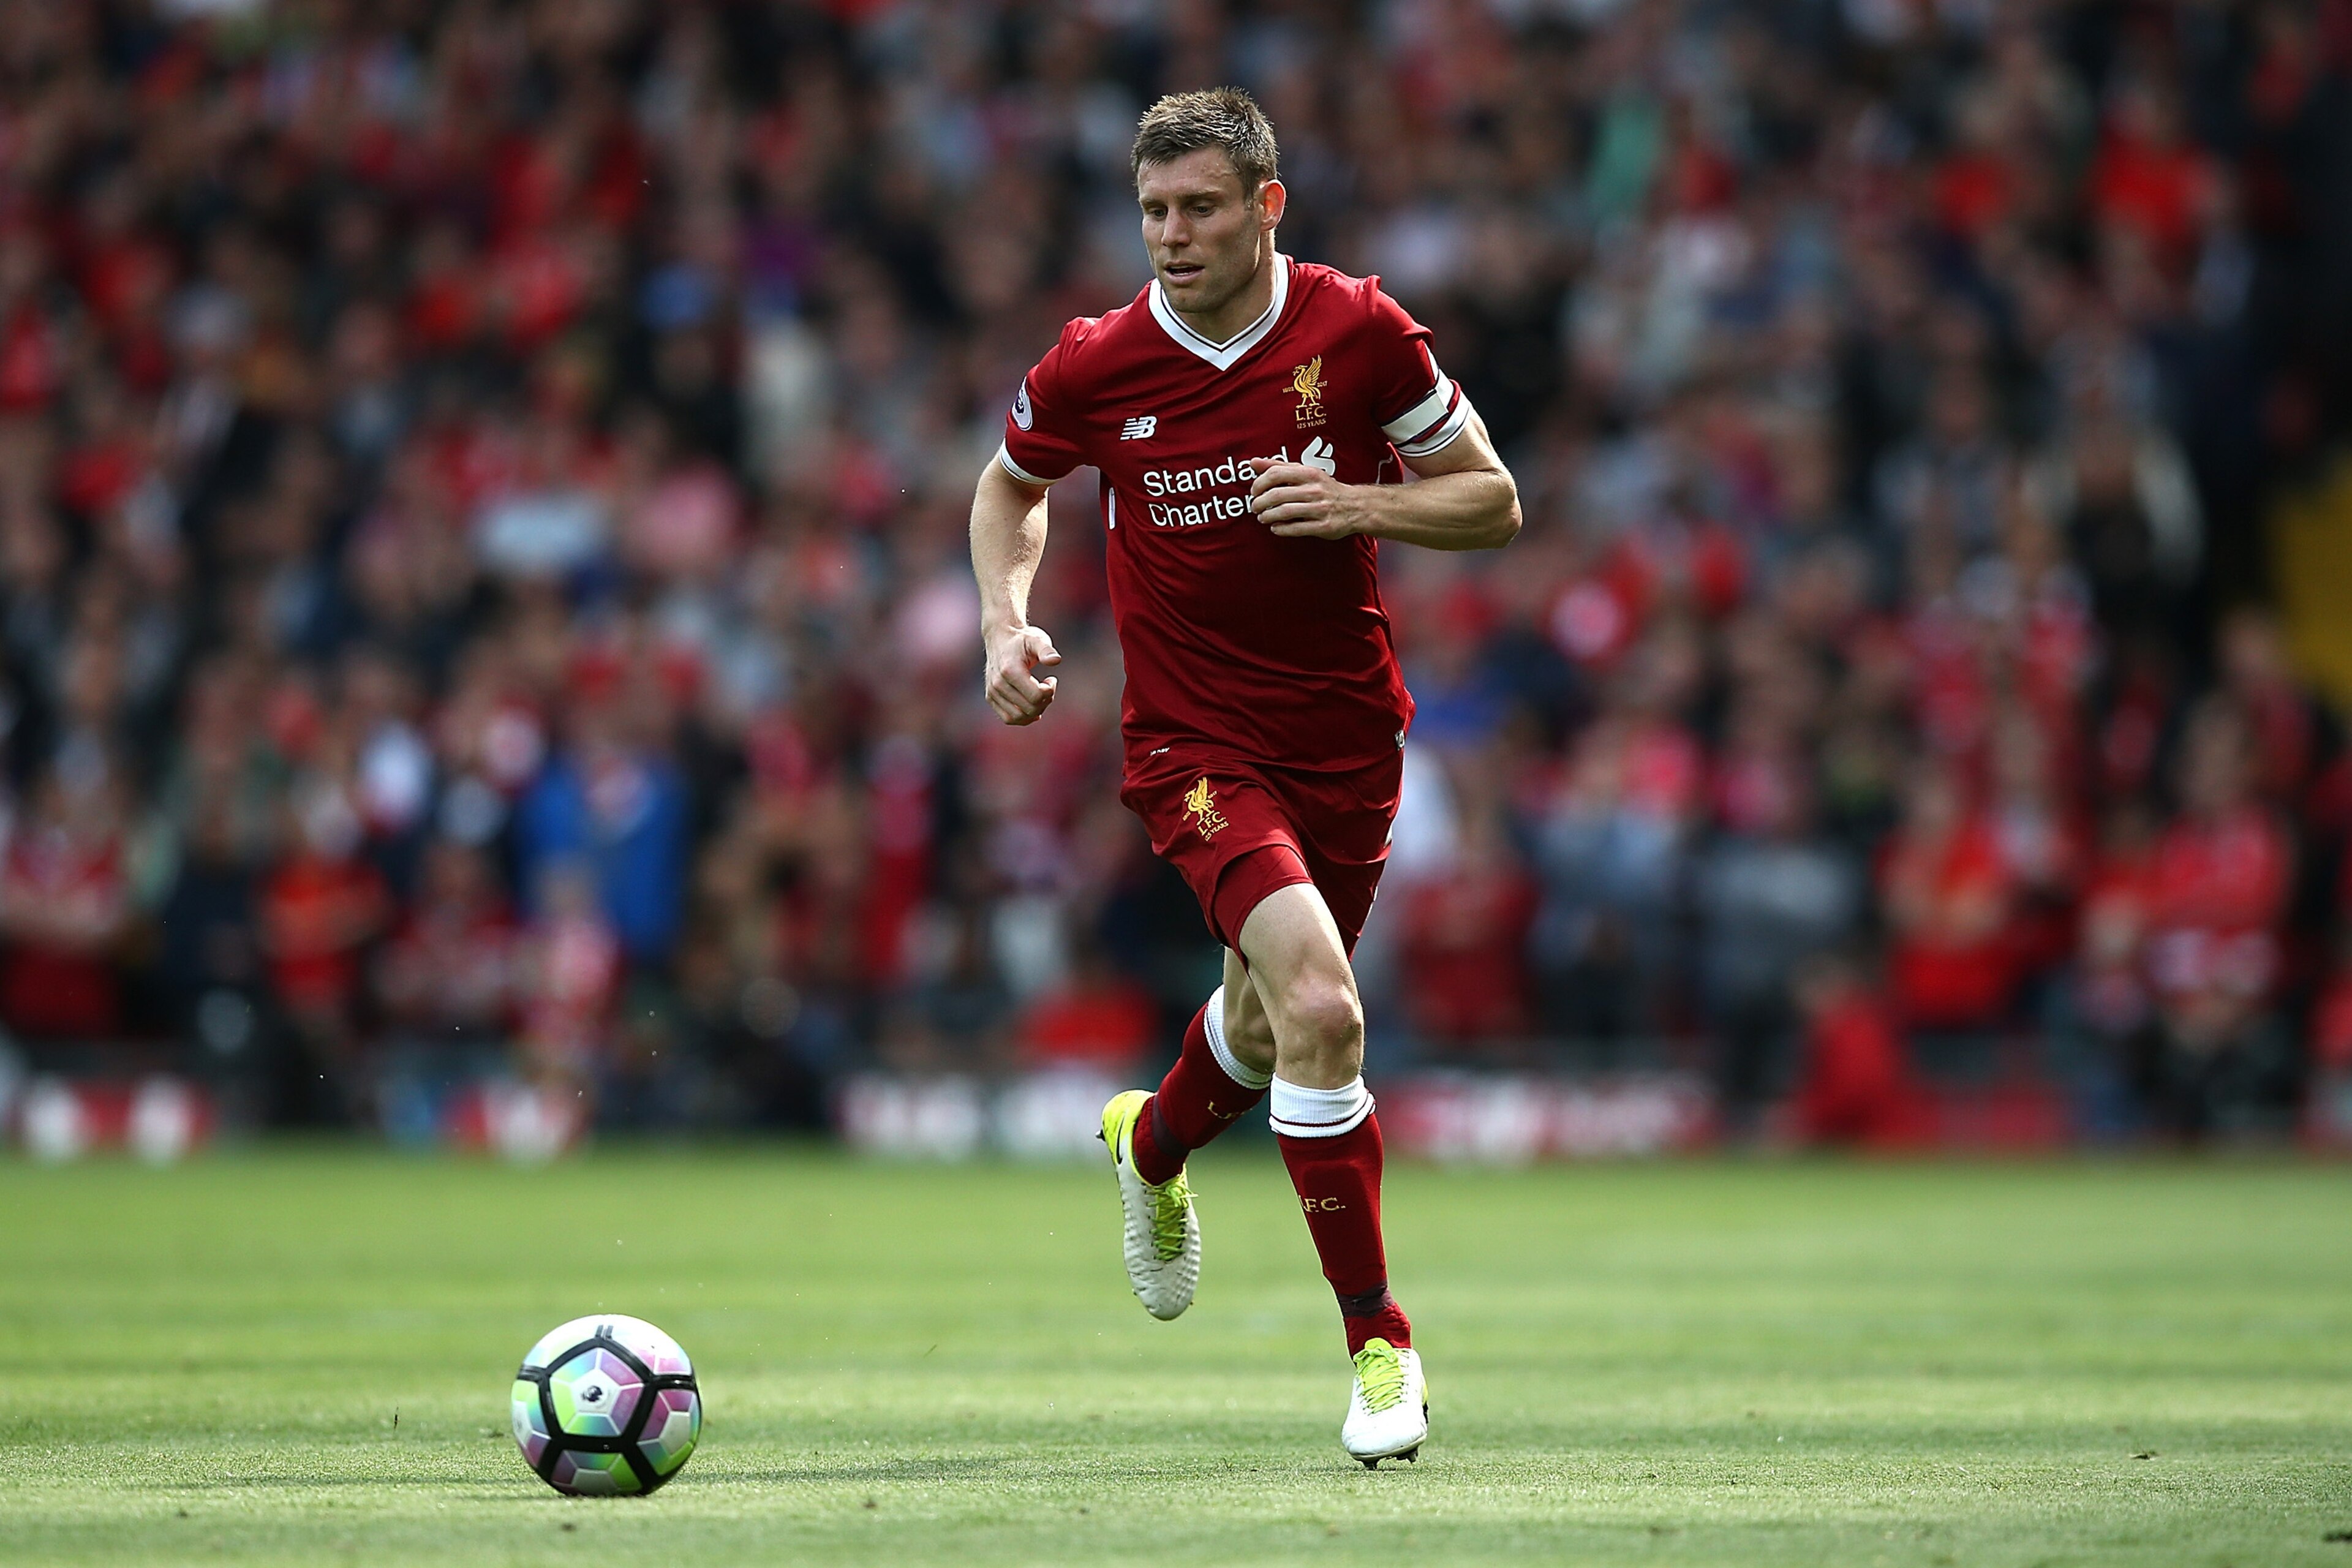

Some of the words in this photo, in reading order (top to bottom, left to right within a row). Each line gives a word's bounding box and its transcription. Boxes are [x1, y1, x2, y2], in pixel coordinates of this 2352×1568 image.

[1295, 406, 1326, 421] L.F.C.
[1307, 418, 1326, 428] YEARS
[1144, 446, 1289, 497] Standad
[1148, 495, 1255, 527] Charter
